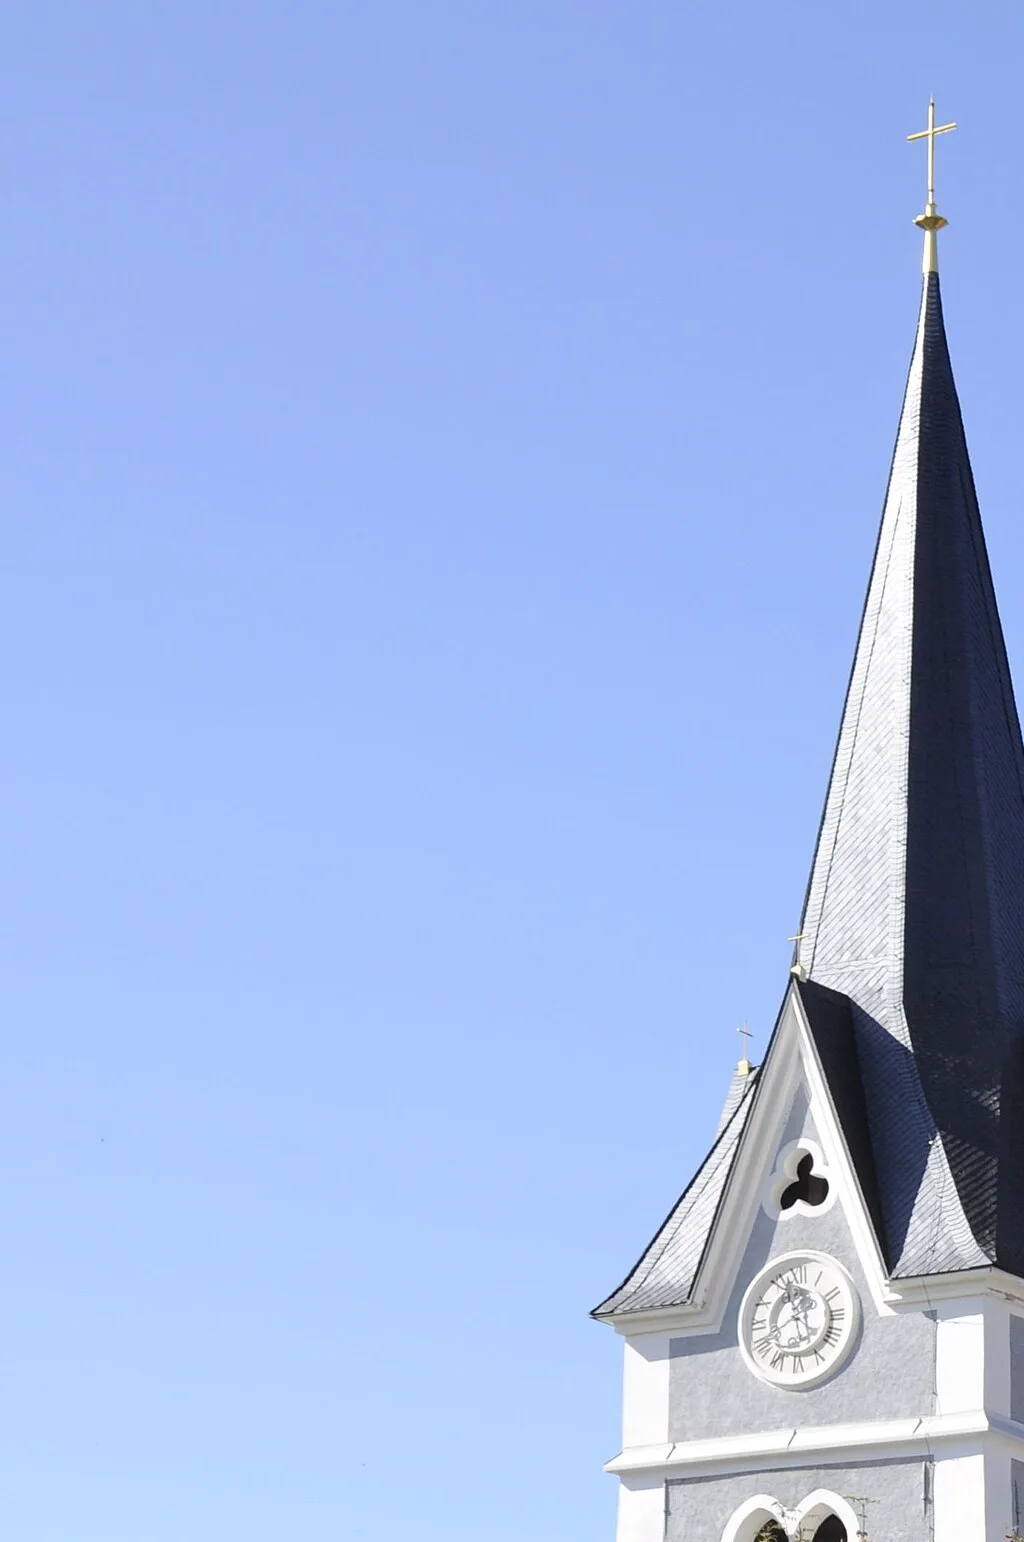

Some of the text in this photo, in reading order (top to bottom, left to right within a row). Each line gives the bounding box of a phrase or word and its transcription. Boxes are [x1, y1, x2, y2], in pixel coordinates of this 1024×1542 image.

[814, 1271, 823, 1286] I
[825, 1286, 841, 1301] II
[829, 1308, 845, 1321] III
